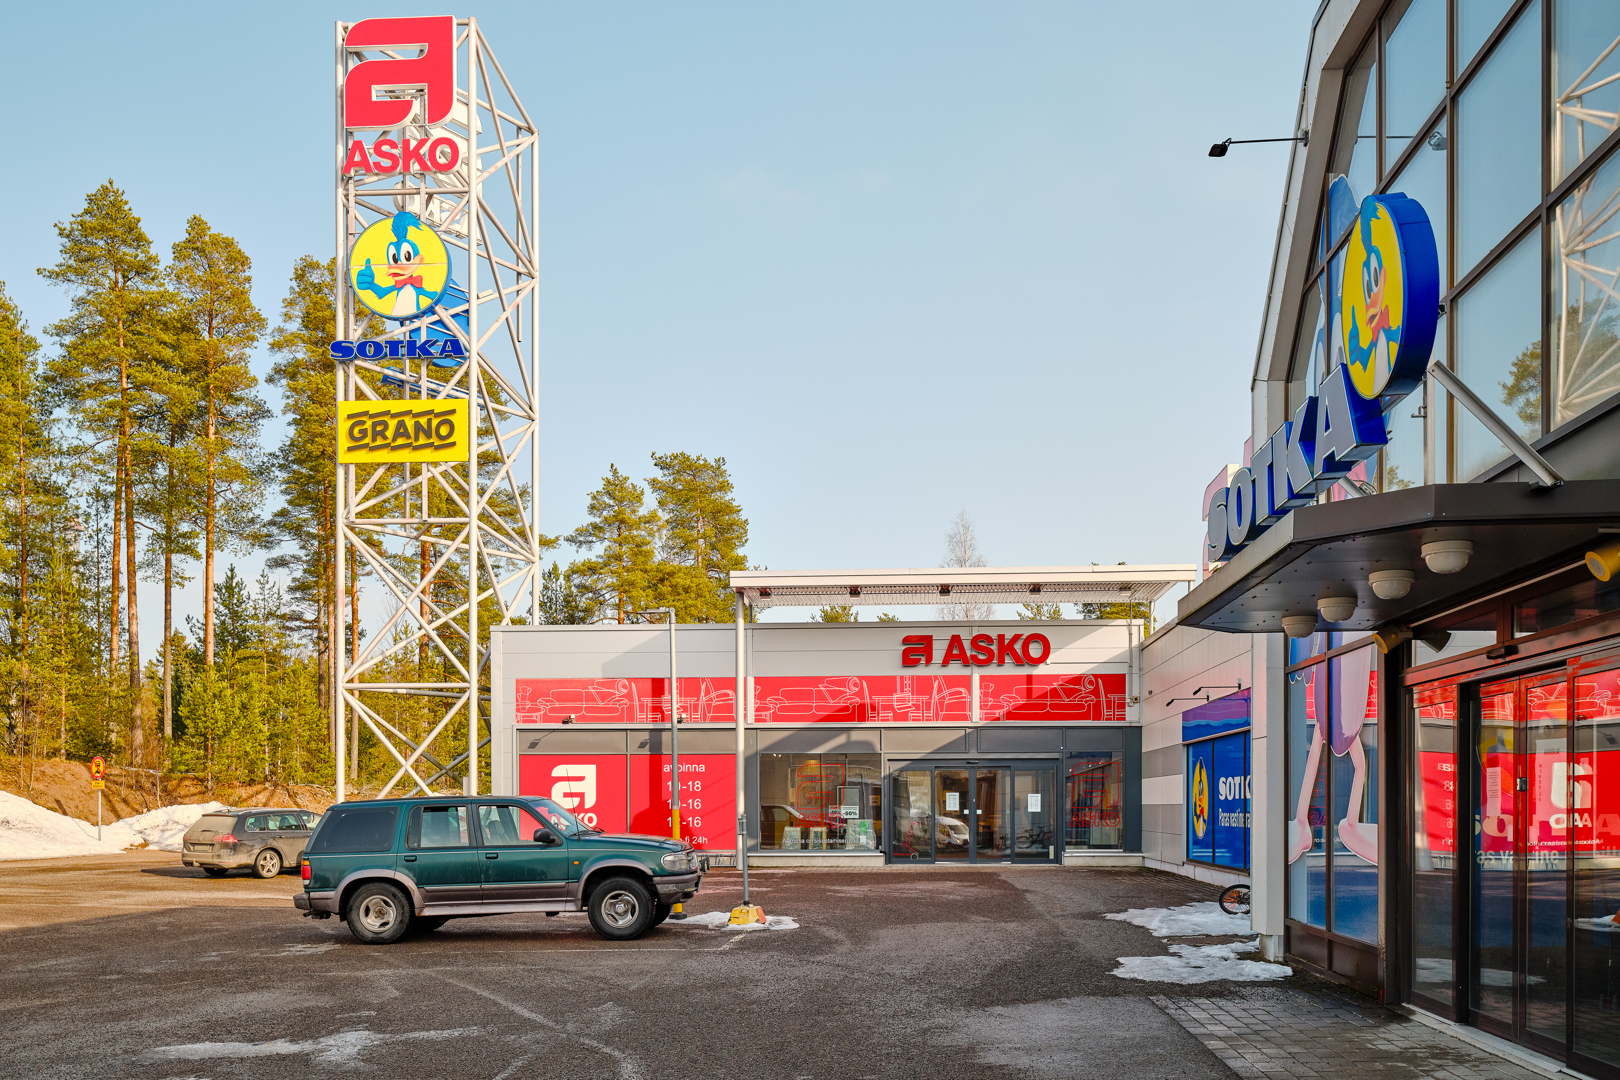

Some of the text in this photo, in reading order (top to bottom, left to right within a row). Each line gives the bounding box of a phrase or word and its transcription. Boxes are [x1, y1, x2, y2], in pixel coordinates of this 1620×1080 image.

[342, 136, 461, 175] ASKO
[329, 337, 468, 361] SOTKA
[348, 417, 456, 443] GRANO
[1207, 362, 1388, 563] SOTKA
[941, 632, 1052, 666] ASKO
[667, 780, 702, 792] 1-18
[667, 798, 702, 810] 1-16
[667, 816, 702, 828] 1-16
[794, 812, 846, 829] ASKO
[1069, 811, 1121, 828] ASKO
[1218, 808, 1230, 827] Paras
[692, 836, 708, 845] 24h
